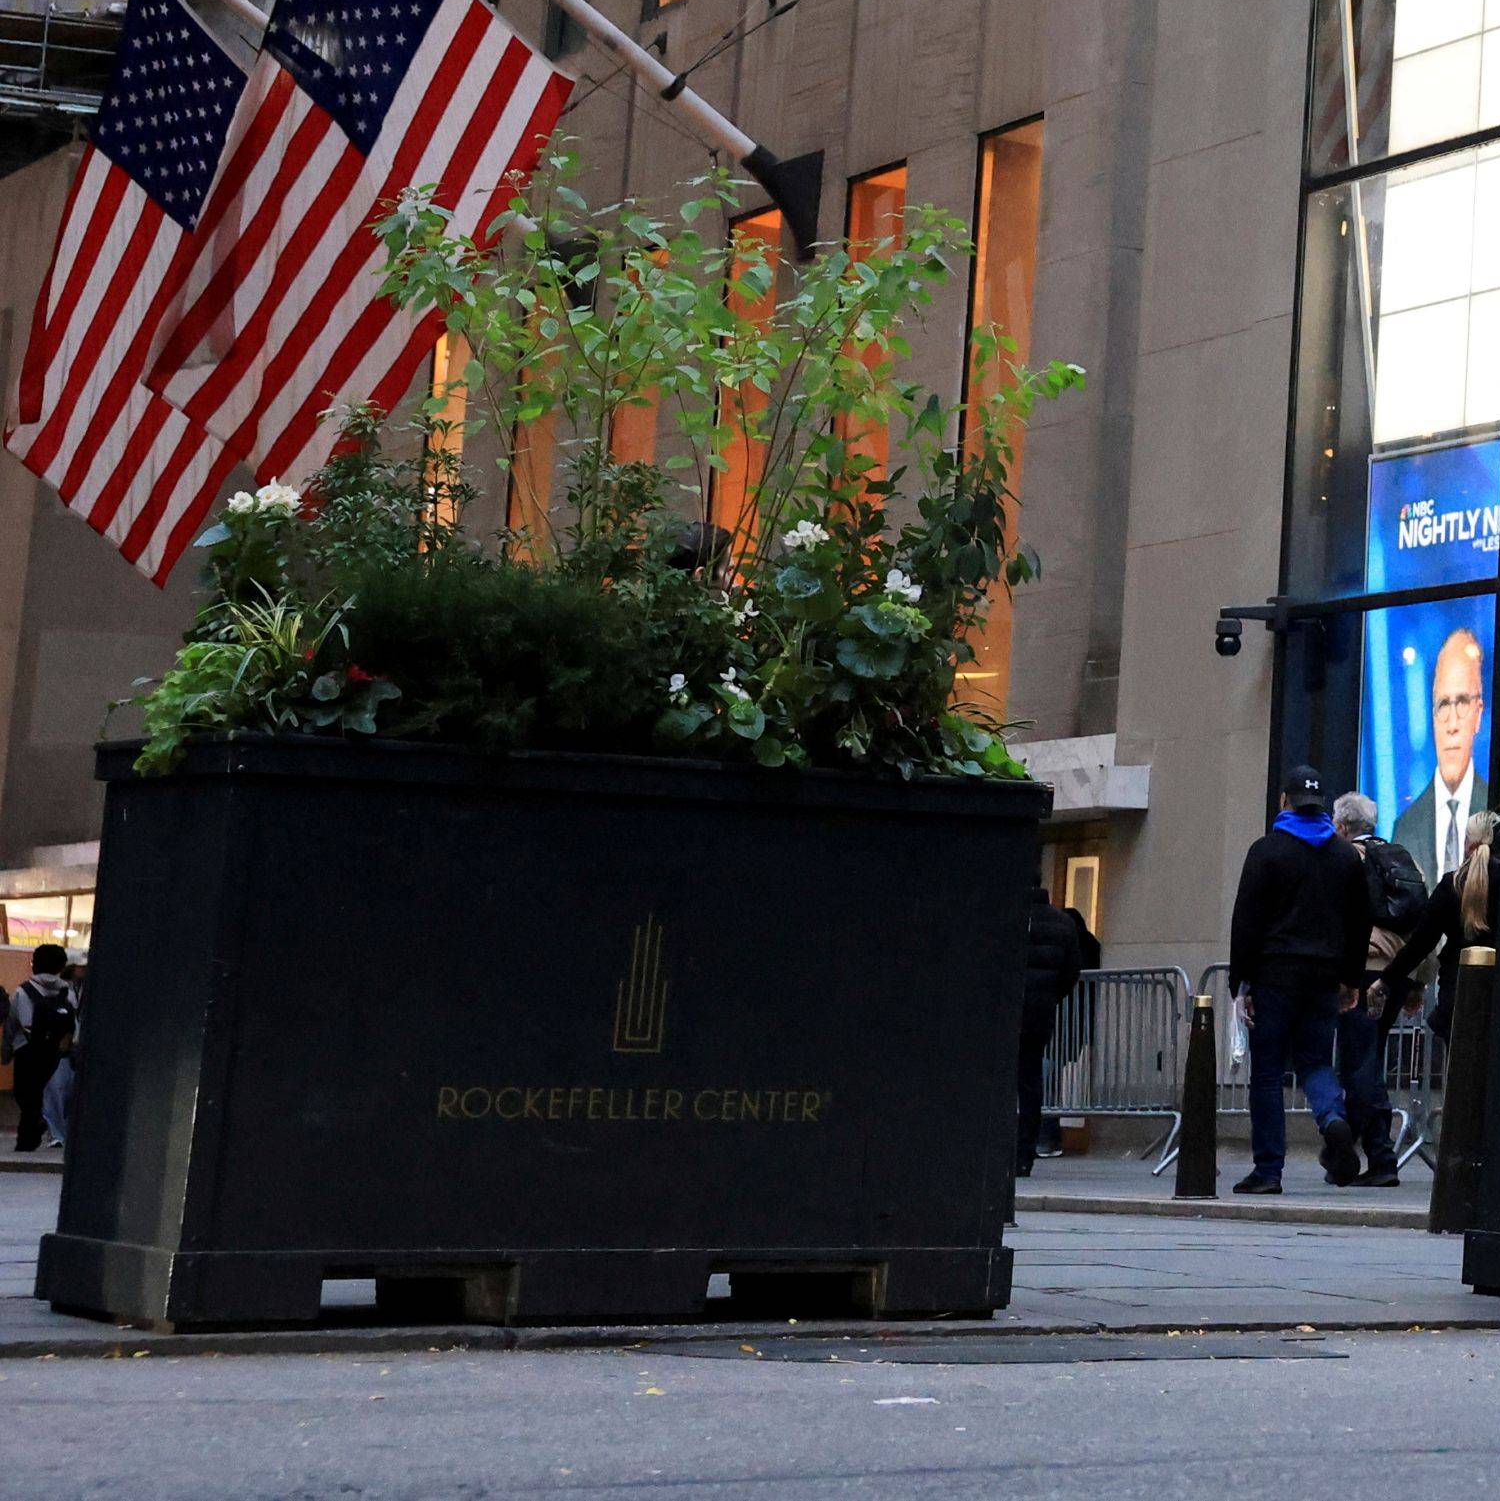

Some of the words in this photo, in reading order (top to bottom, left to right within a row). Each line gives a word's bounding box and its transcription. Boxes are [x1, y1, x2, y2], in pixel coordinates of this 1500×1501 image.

[1412, 499, 1435, 518] NBC
[1398, 508, 1482, 550] NIGHTLY
[1482, 535, 1500, 552] LES
[437, 1086, 683, 1120] ROCKEFELLER
[694, 1089, 821, 1122] CENTER
